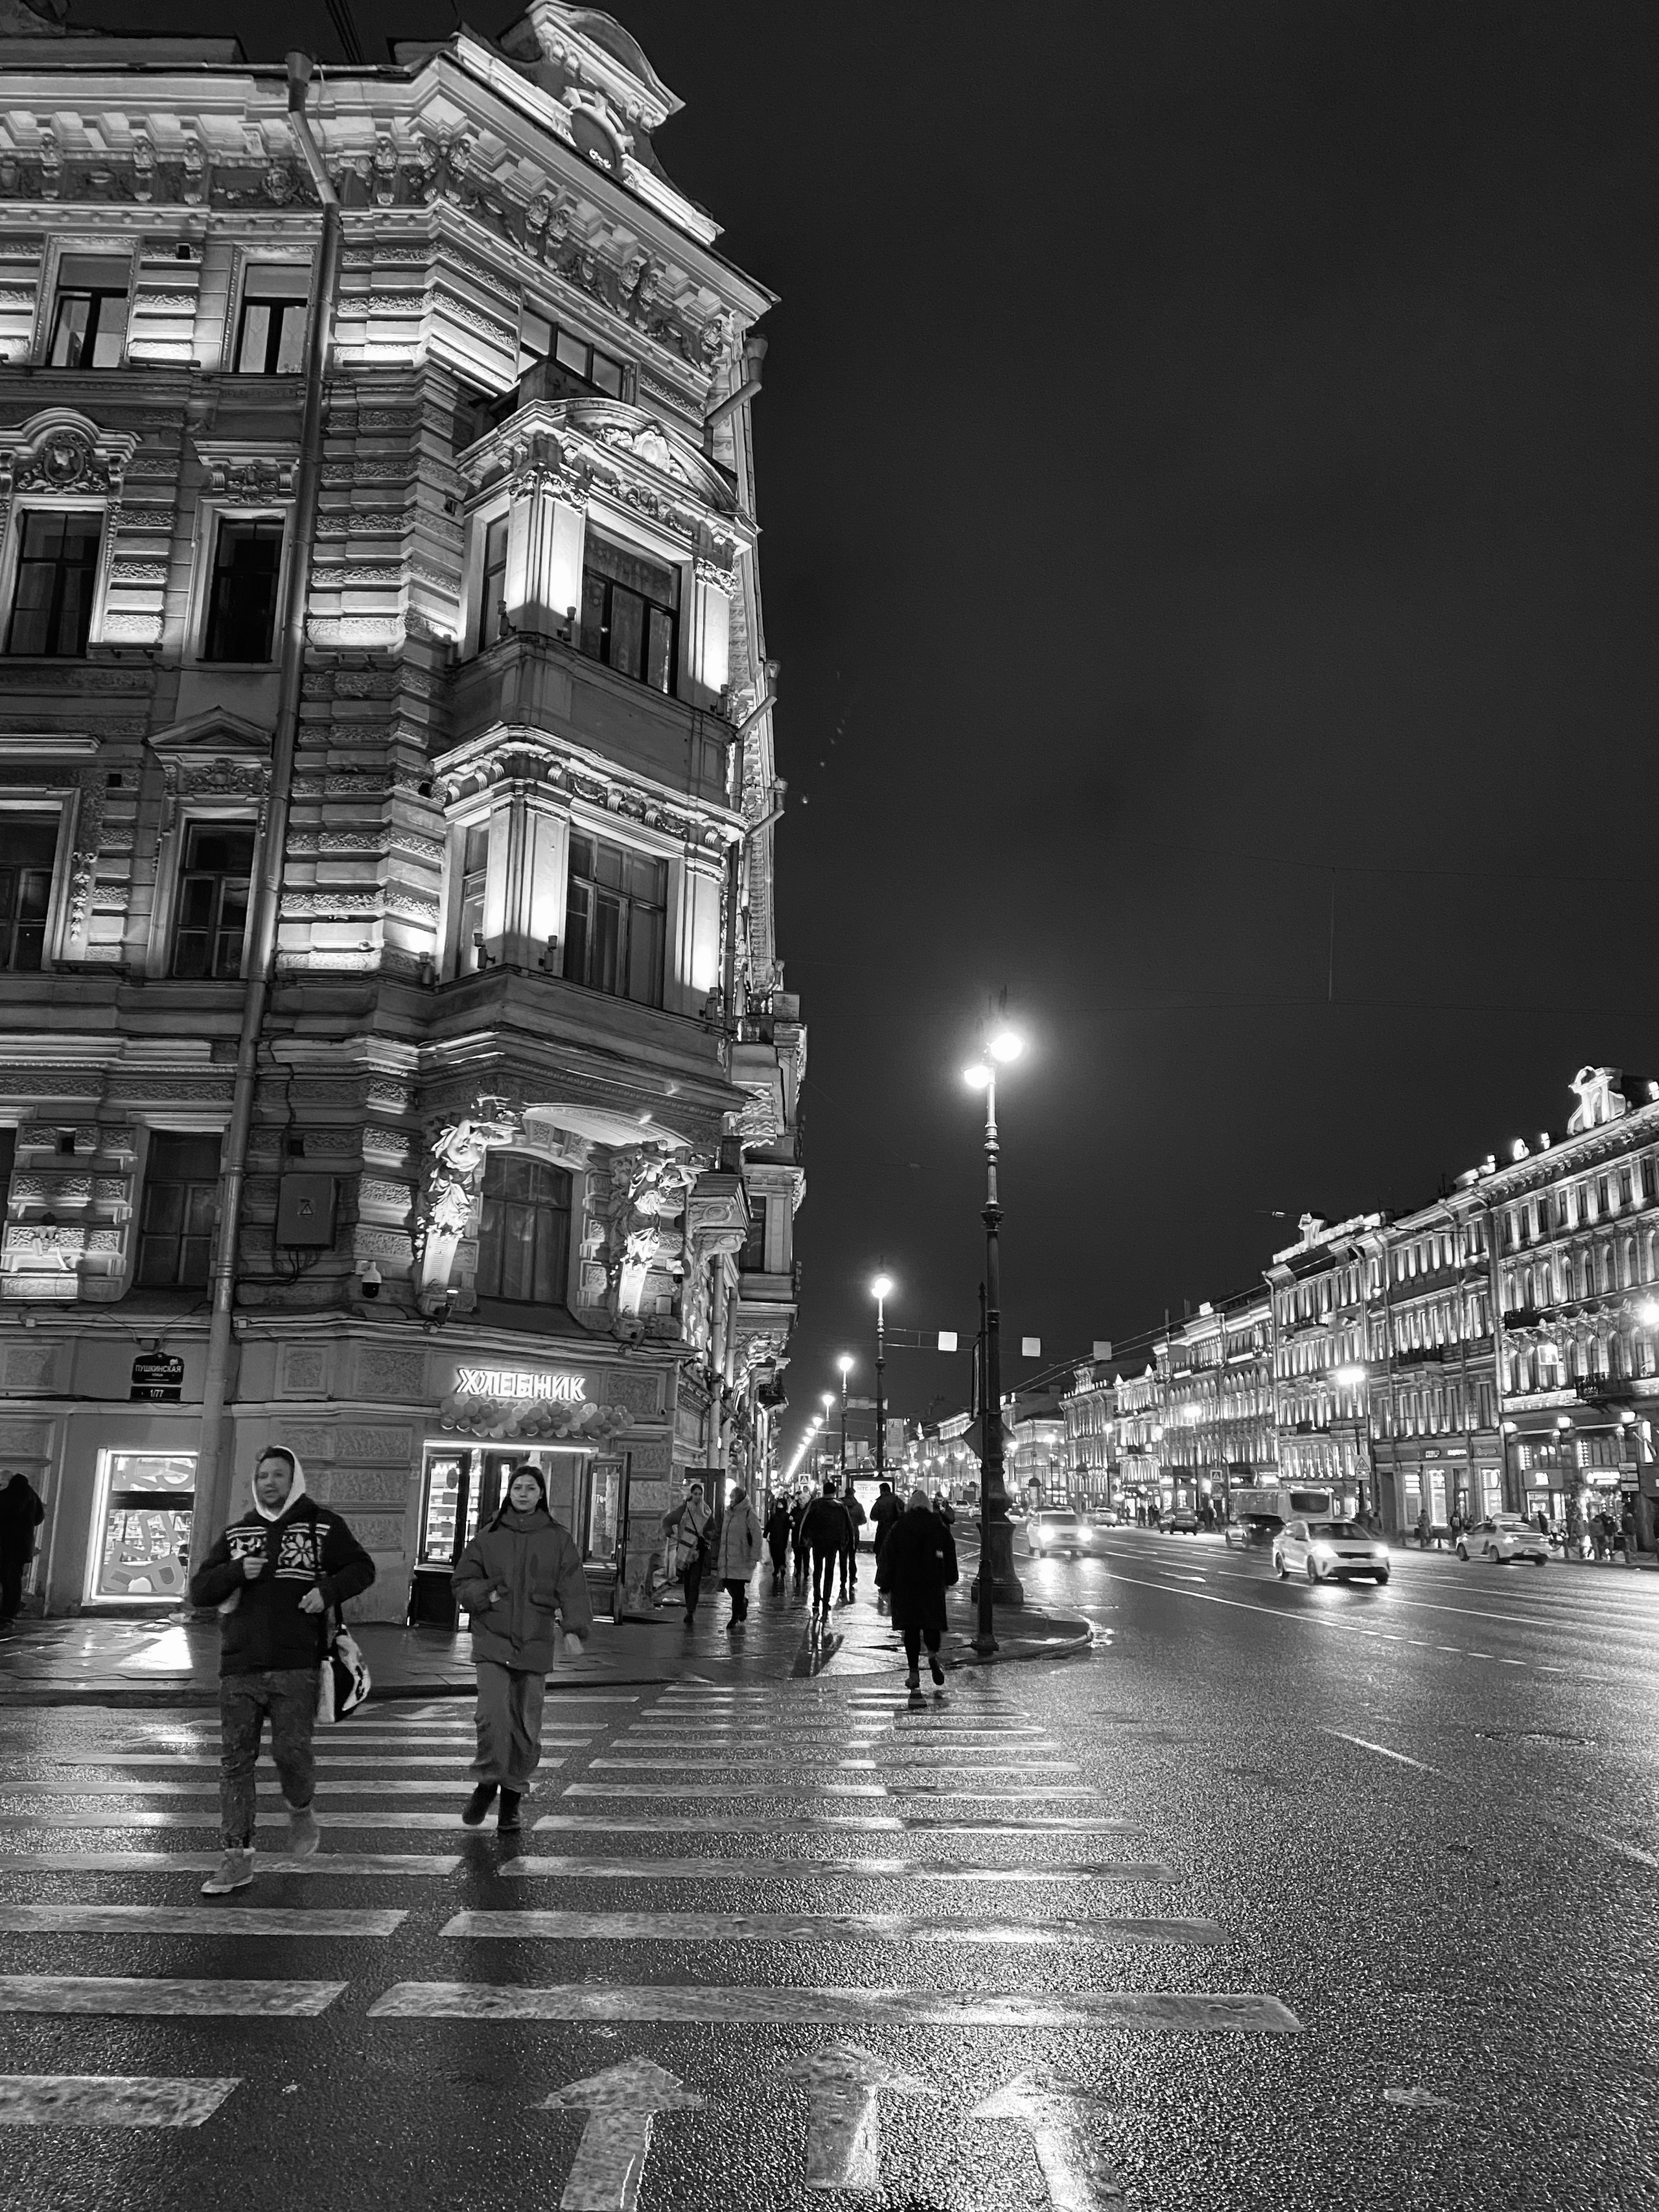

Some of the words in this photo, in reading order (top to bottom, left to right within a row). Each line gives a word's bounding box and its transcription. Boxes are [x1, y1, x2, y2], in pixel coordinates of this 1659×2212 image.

[135, 1364, 181, 1373] ПУШКИНСКАЯ
[456, 1368, 586, 1402] ХЛЕБНИК
[150, 1389, 165, 1398] 1/77
